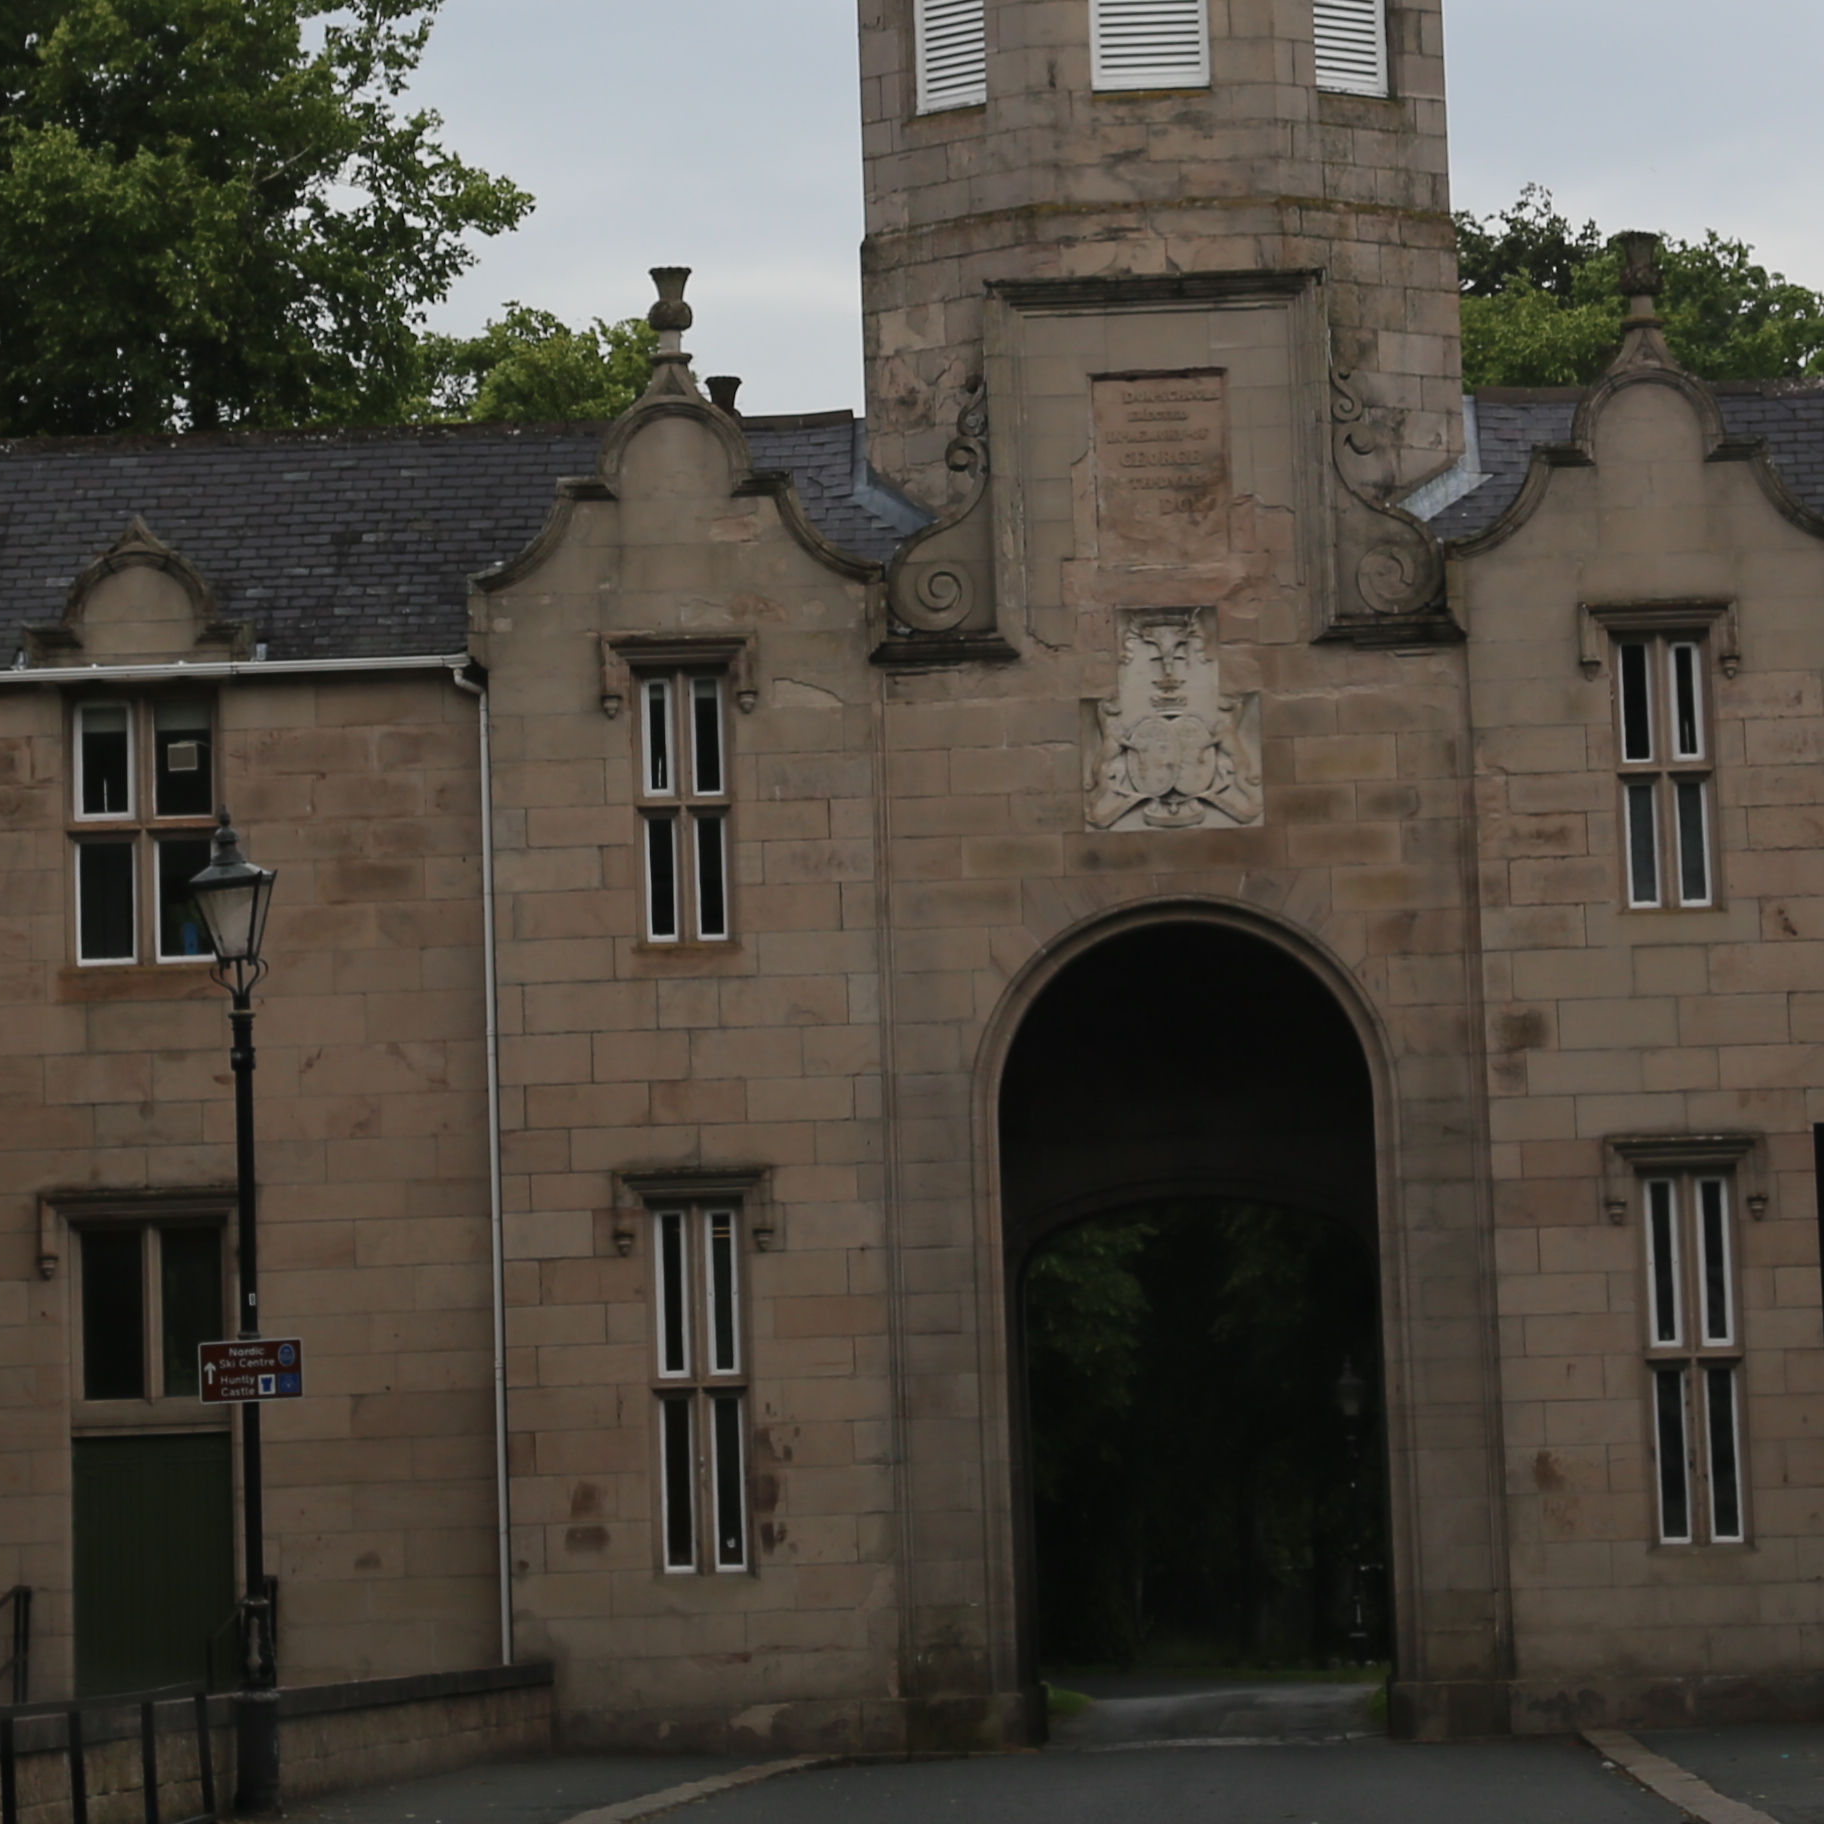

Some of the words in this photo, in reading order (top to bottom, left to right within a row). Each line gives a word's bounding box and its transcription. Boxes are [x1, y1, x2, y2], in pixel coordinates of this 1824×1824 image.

[1119, 450, 1202, 468] GEORGE
[229, 1347, 265, 1357] Nordic
[219, 1359, 235, 1369] Ski
[239, 1358, 275, 1368] Centre
[220, 1375, 256, 1385] Huntly
[221, 1387, 256, 1397] Castle
